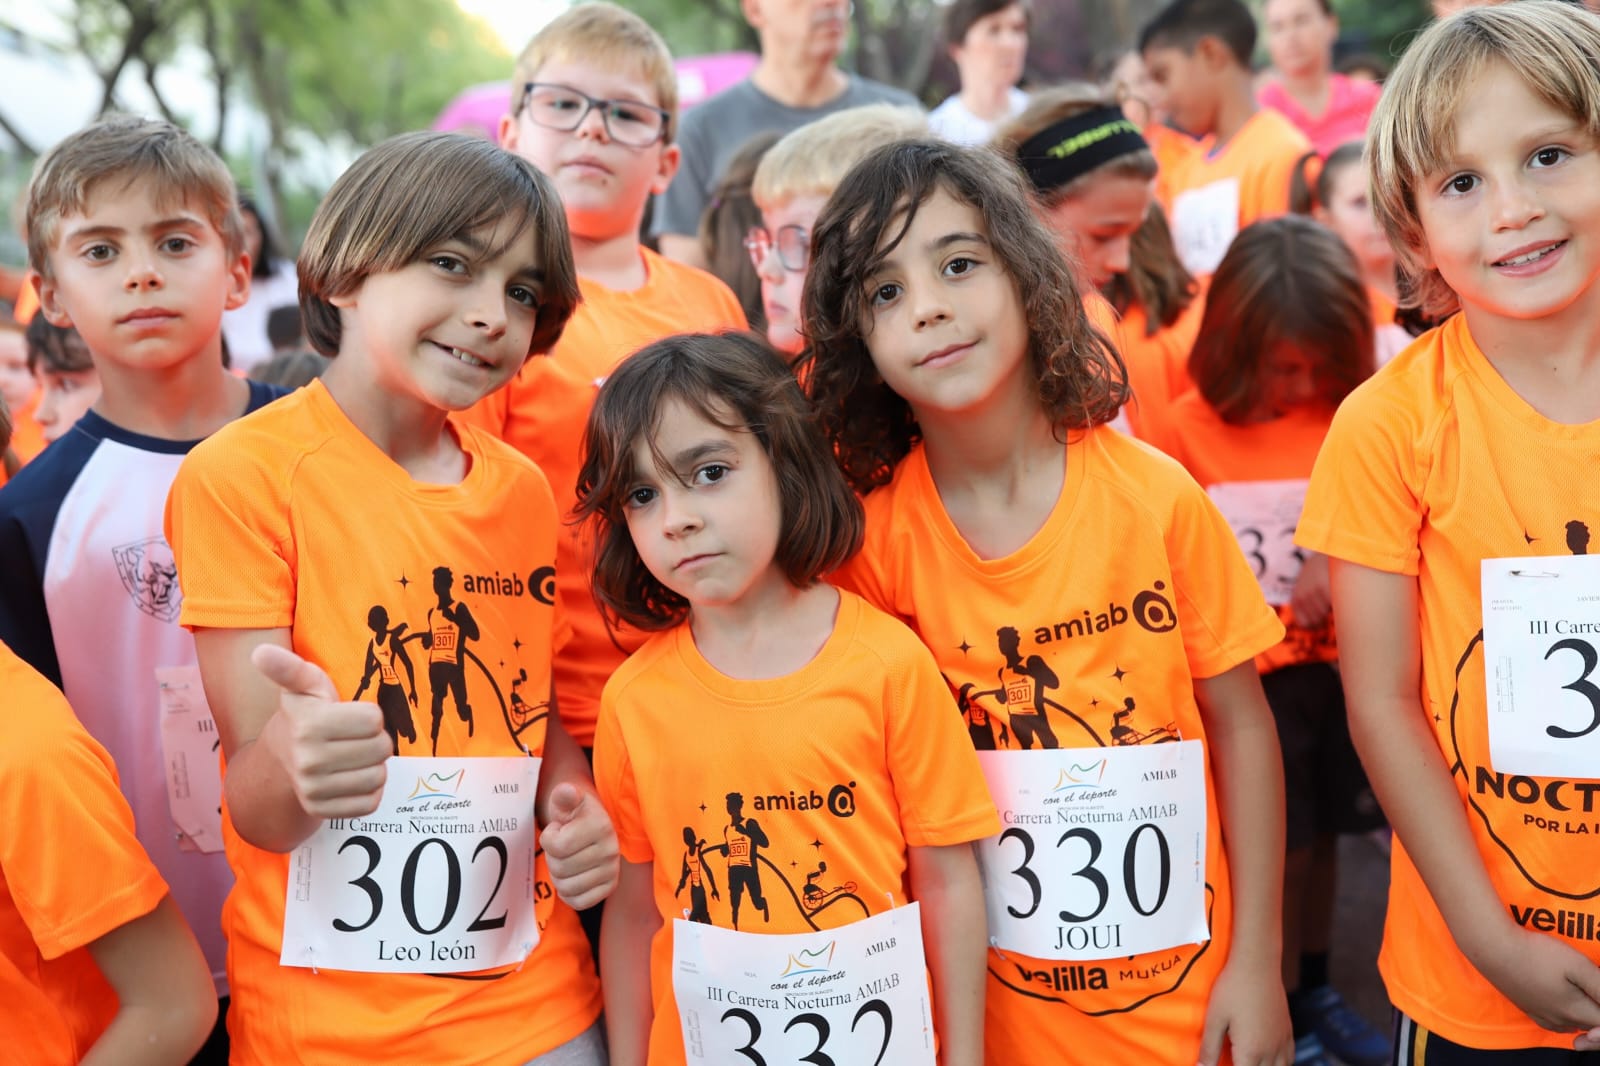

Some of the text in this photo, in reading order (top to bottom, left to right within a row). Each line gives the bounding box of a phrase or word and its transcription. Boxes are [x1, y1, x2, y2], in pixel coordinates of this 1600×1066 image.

[463, 571, 524, 597] amiab
[1034, 602, 1128, 645] amiab
[1530, 620, 1548, 635] III
[435, 635, 452, 648] 301
[1009, 689, 1029, 703] 301
[1141, 768, 1178, 782] AMIAB
[491, 783, 520, 795] AMIAB
[1043, 788, 1118, 805] con el deporte
[395, 799, 473, 814] con el deporte
[753, 790, 824, 811] amiab
[1003, 810, 1052, 825] Carrera
[1056, 809, 1124, 825] Nocturna
[1127, 803, 1178, 822] AMIAB
[1523, 813, 1560, 833] POR
[1565, 822, 1590, 835] LA
[349, 818, 403, 834] Carrera
[408, 819, 475, 835] Nocturna
[478, 817, 518, 832] AMIAB
[731, 844, 746, 856] 301
[998, 823, 1171, 924] 330
[332, 835, 509, 935] 302
[864, 937, 897, 958] AMIAB
[1054, 923, 1123, 951] JOUI
[378, 940, 476, 962] Leo león
[1119, 954, 1182, 981] MUKUA
[770, 969, 847, 991] con el deporte
[707, 986, 722, 1001] III
[727, 991, 780, 1010] Carrera
[784, 991, 852, 1011] Nocturna
[855, 972, 901, 1001] AMIAB
